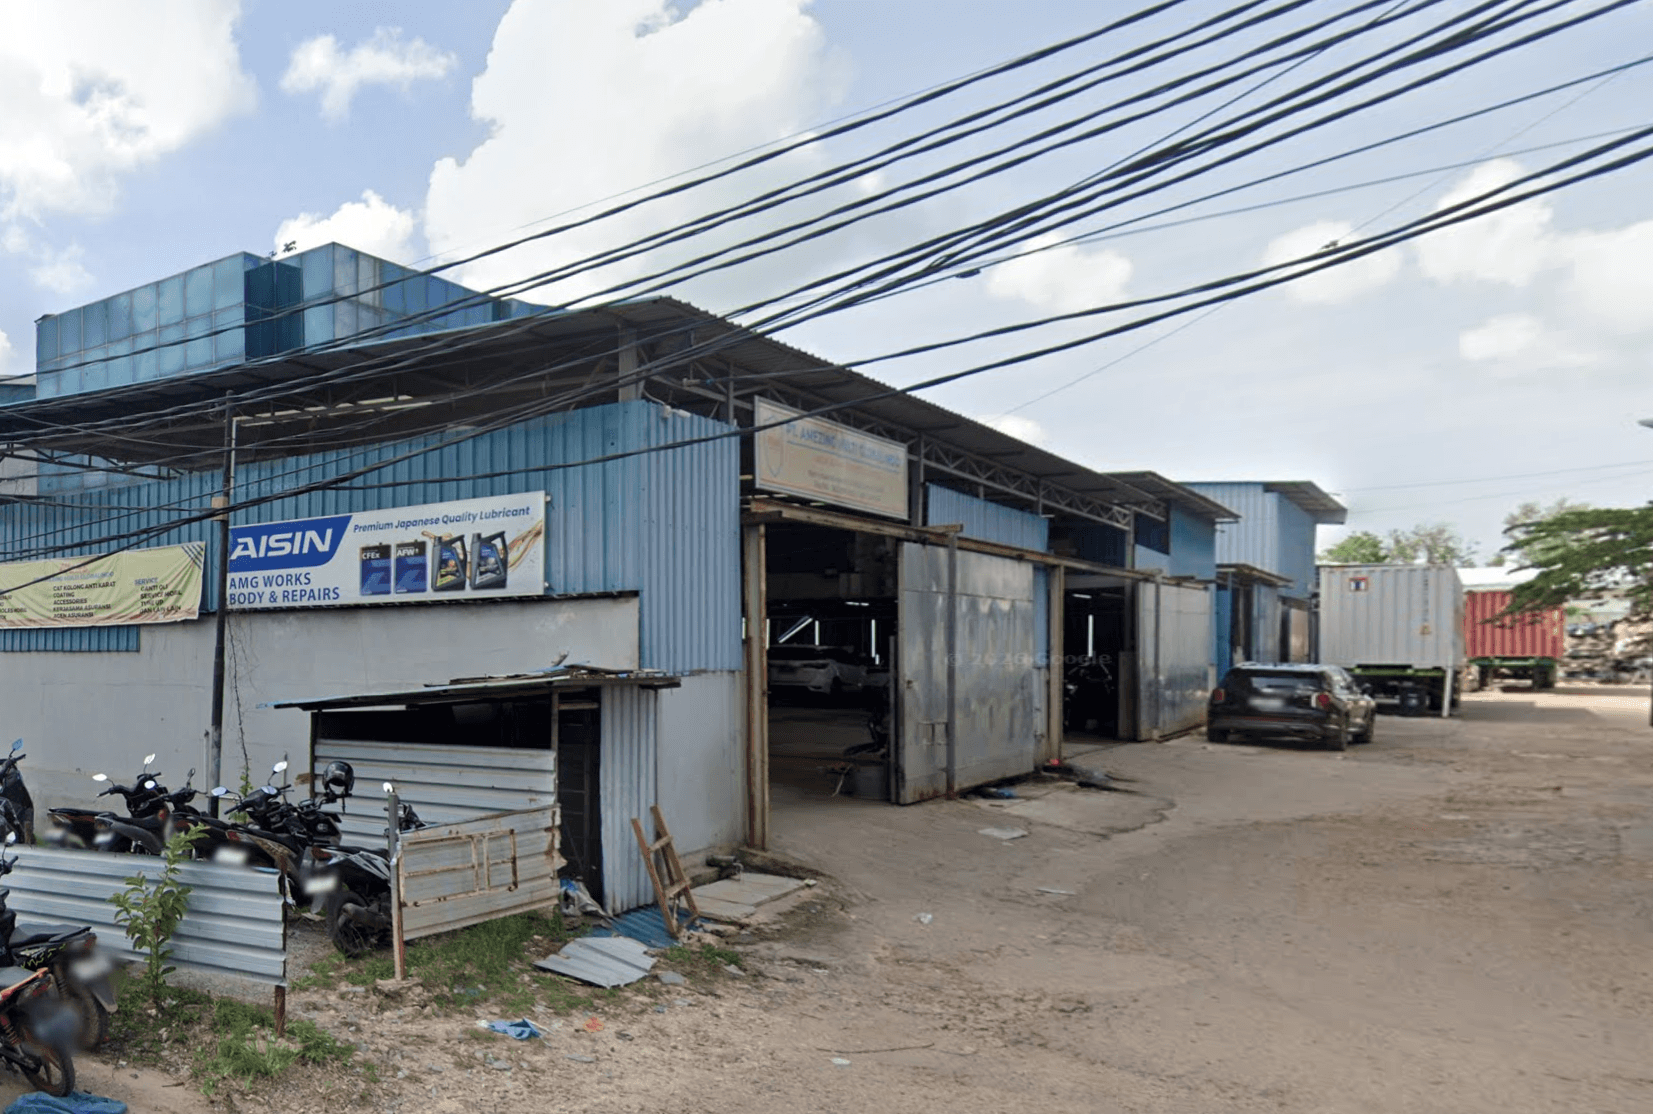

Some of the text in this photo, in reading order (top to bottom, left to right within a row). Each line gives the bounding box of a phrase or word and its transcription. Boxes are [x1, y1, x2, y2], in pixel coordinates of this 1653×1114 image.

[353, 505, 531, 533] Premium Japanese Quality Lubricant
[230, 528, 333, 560] AISIN
[229, 572, 312, 590] AMG WORKS
[229, 586, 340, 605] BODY & REPAIRS
